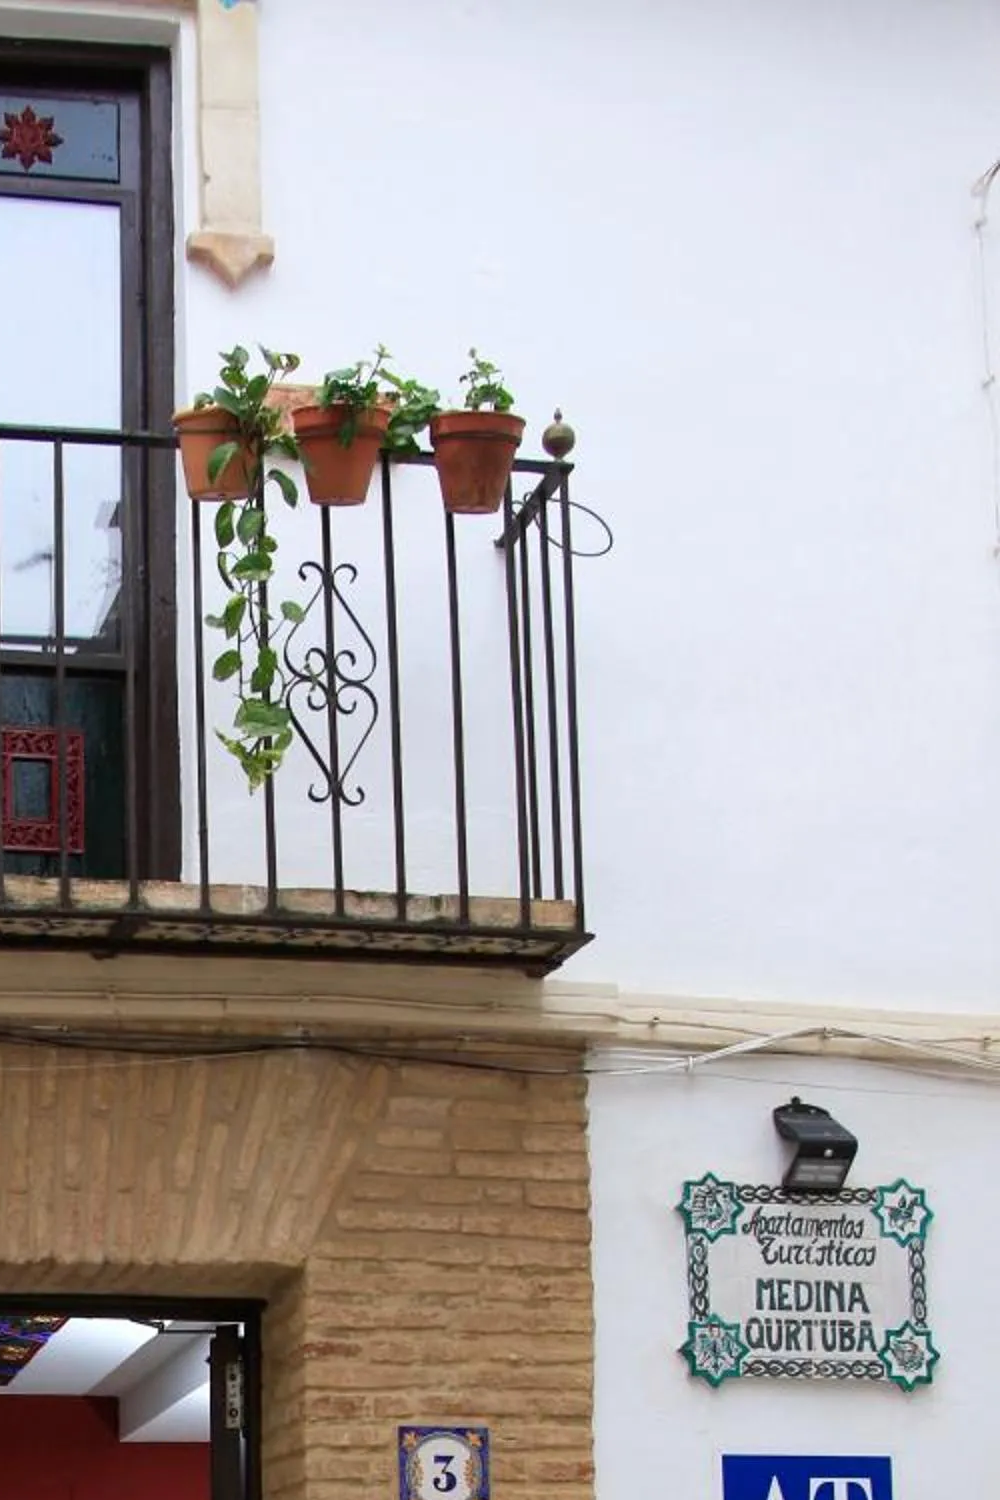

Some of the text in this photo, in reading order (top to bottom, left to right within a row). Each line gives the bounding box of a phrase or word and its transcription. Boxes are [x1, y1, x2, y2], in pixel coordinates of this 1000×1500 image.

[742, 1206, 865, 1244] Apartamentos
[761, 1238, 876, 1267] Turísticos
[755, 1278, 871, 1314] MEDINA
[745, 1317, 878, 1353] QURTUBA
[433, 1455, 457, 1492] 3
